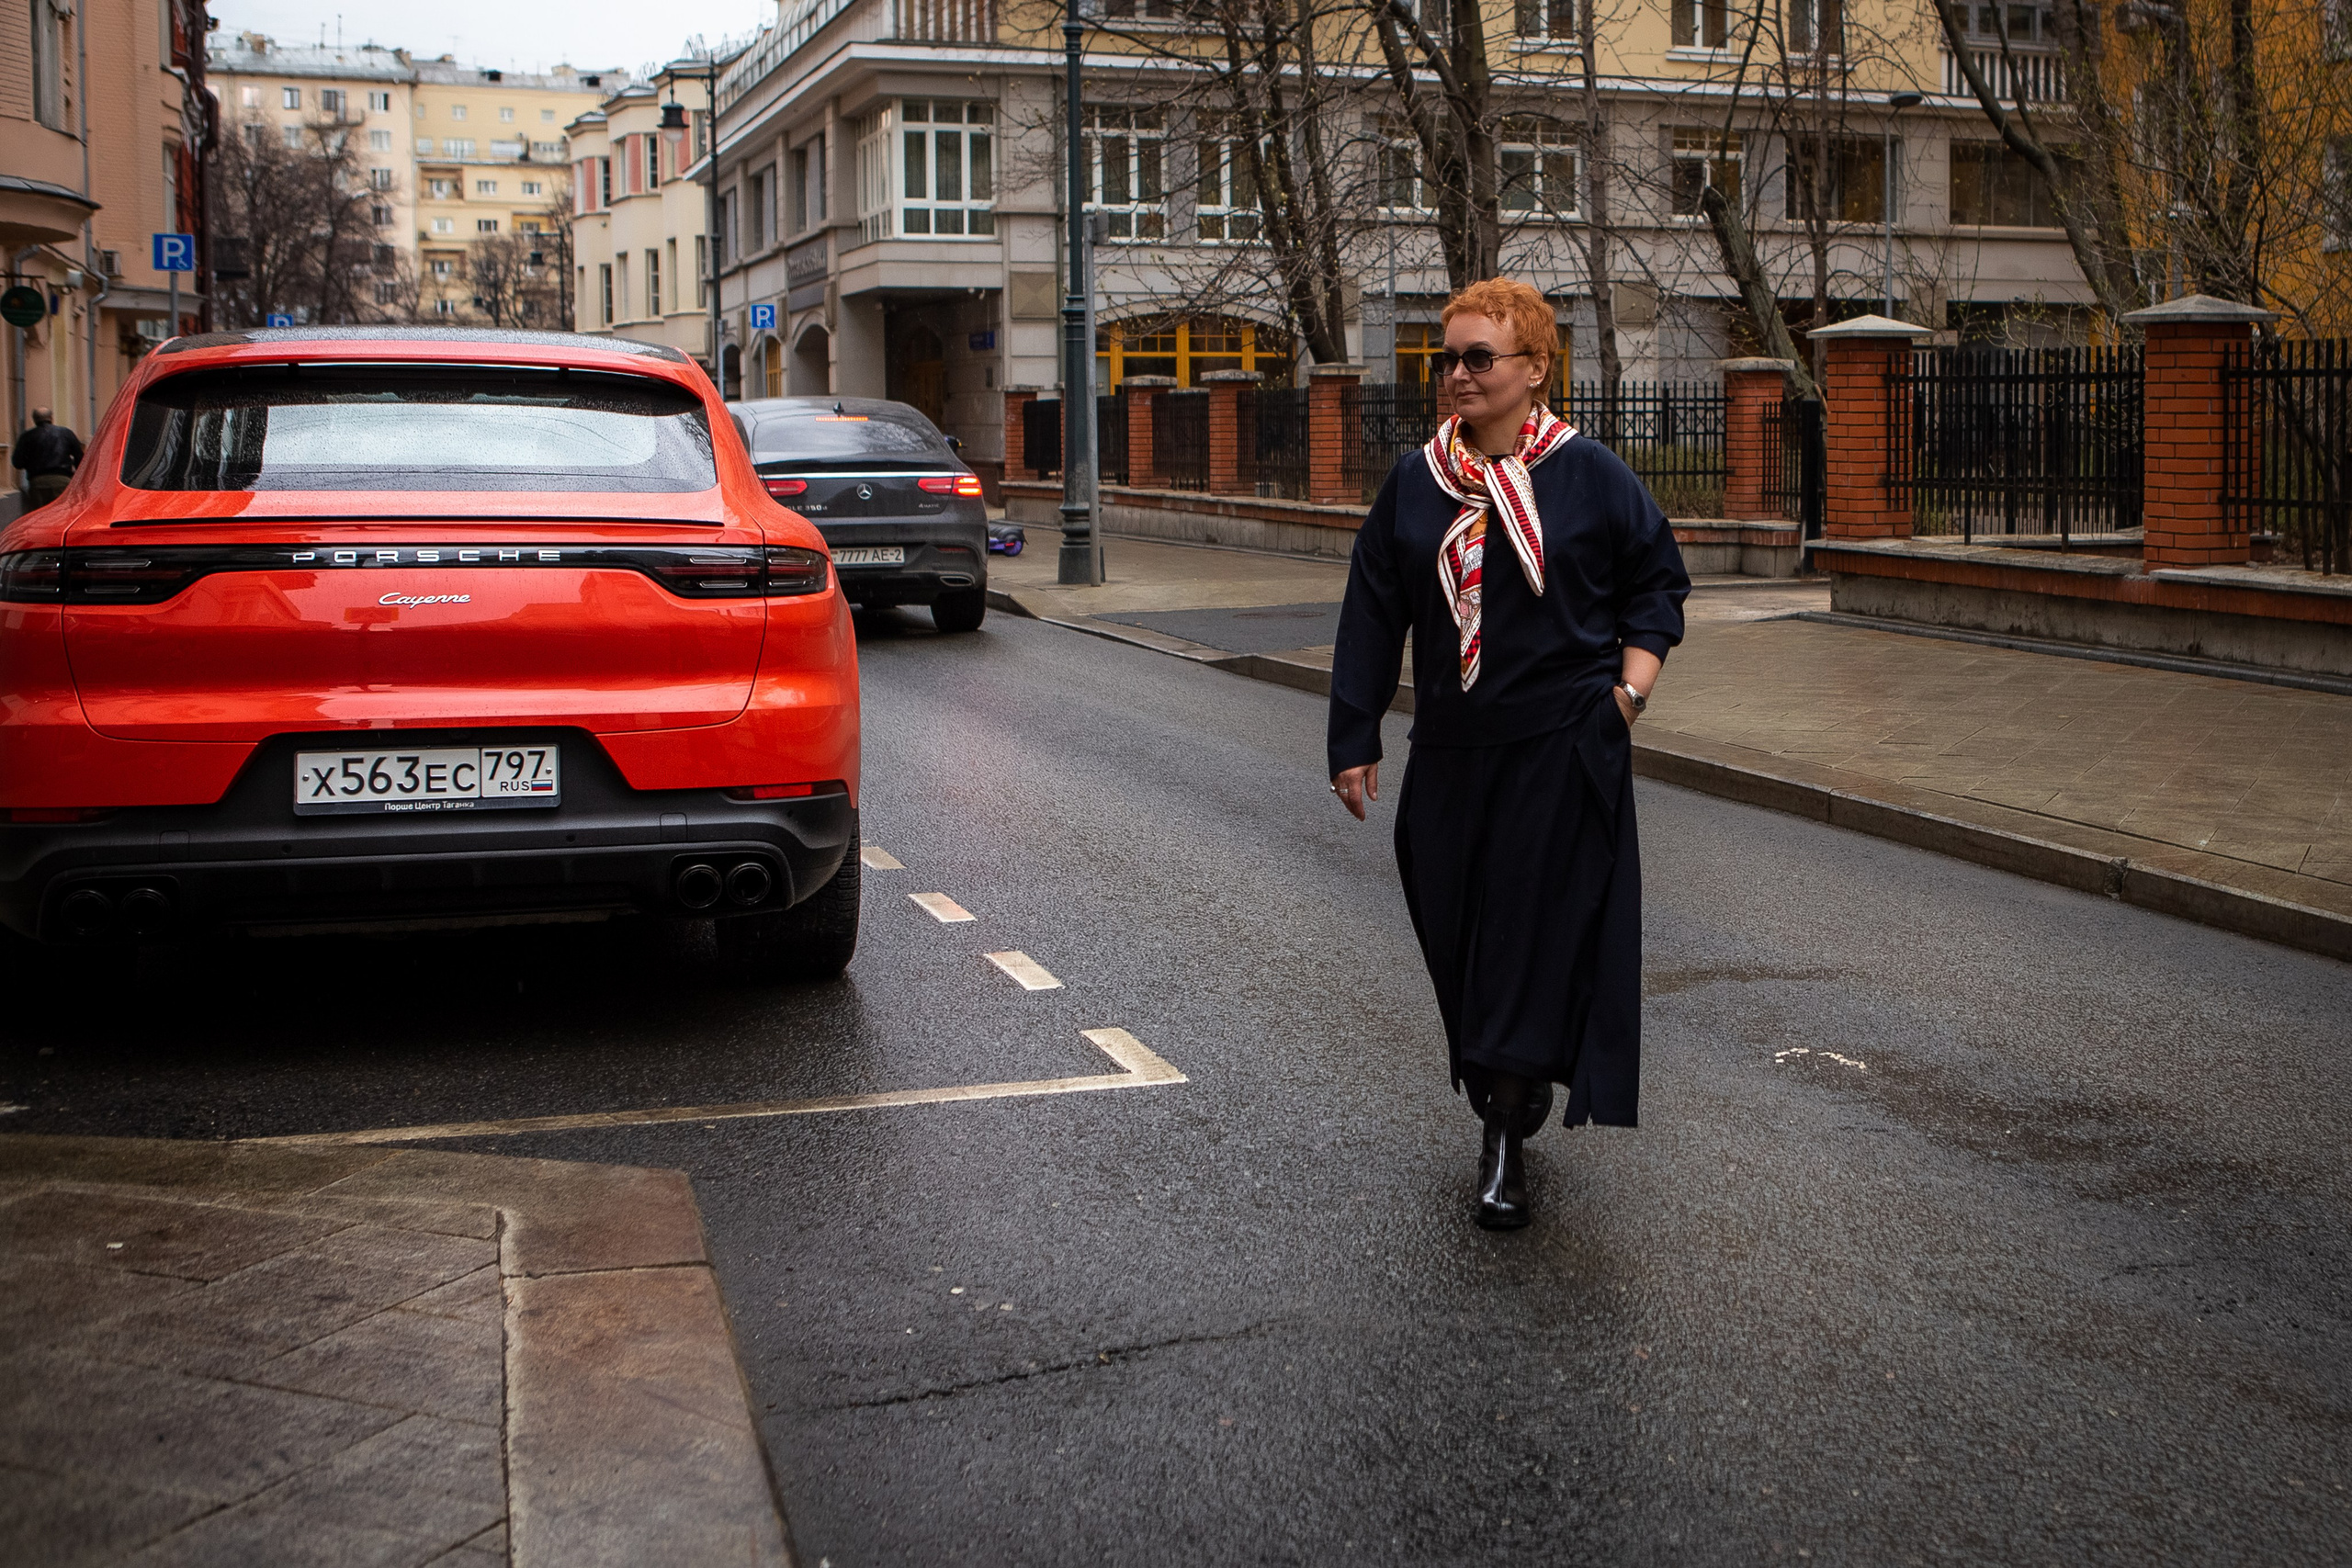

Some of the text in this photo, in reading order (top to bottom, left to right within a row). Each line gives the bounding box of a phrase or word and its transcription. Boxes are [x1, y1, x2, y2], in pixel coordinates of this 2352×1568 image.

[162, 236, 186, 267] P
[756, 306, 771, 327] P
[292, 549, 561, 563] PORSCHE
[840, 549, 868, 562] 7777
[872, 548, 902, 562] AE-2
[379, 592, 471, 608] Cayenne
[483, 750, 547, 781] 797
[499, 781, 530, 792] RUS
[384, 800, 475, 811] Порше Центр Таганка
